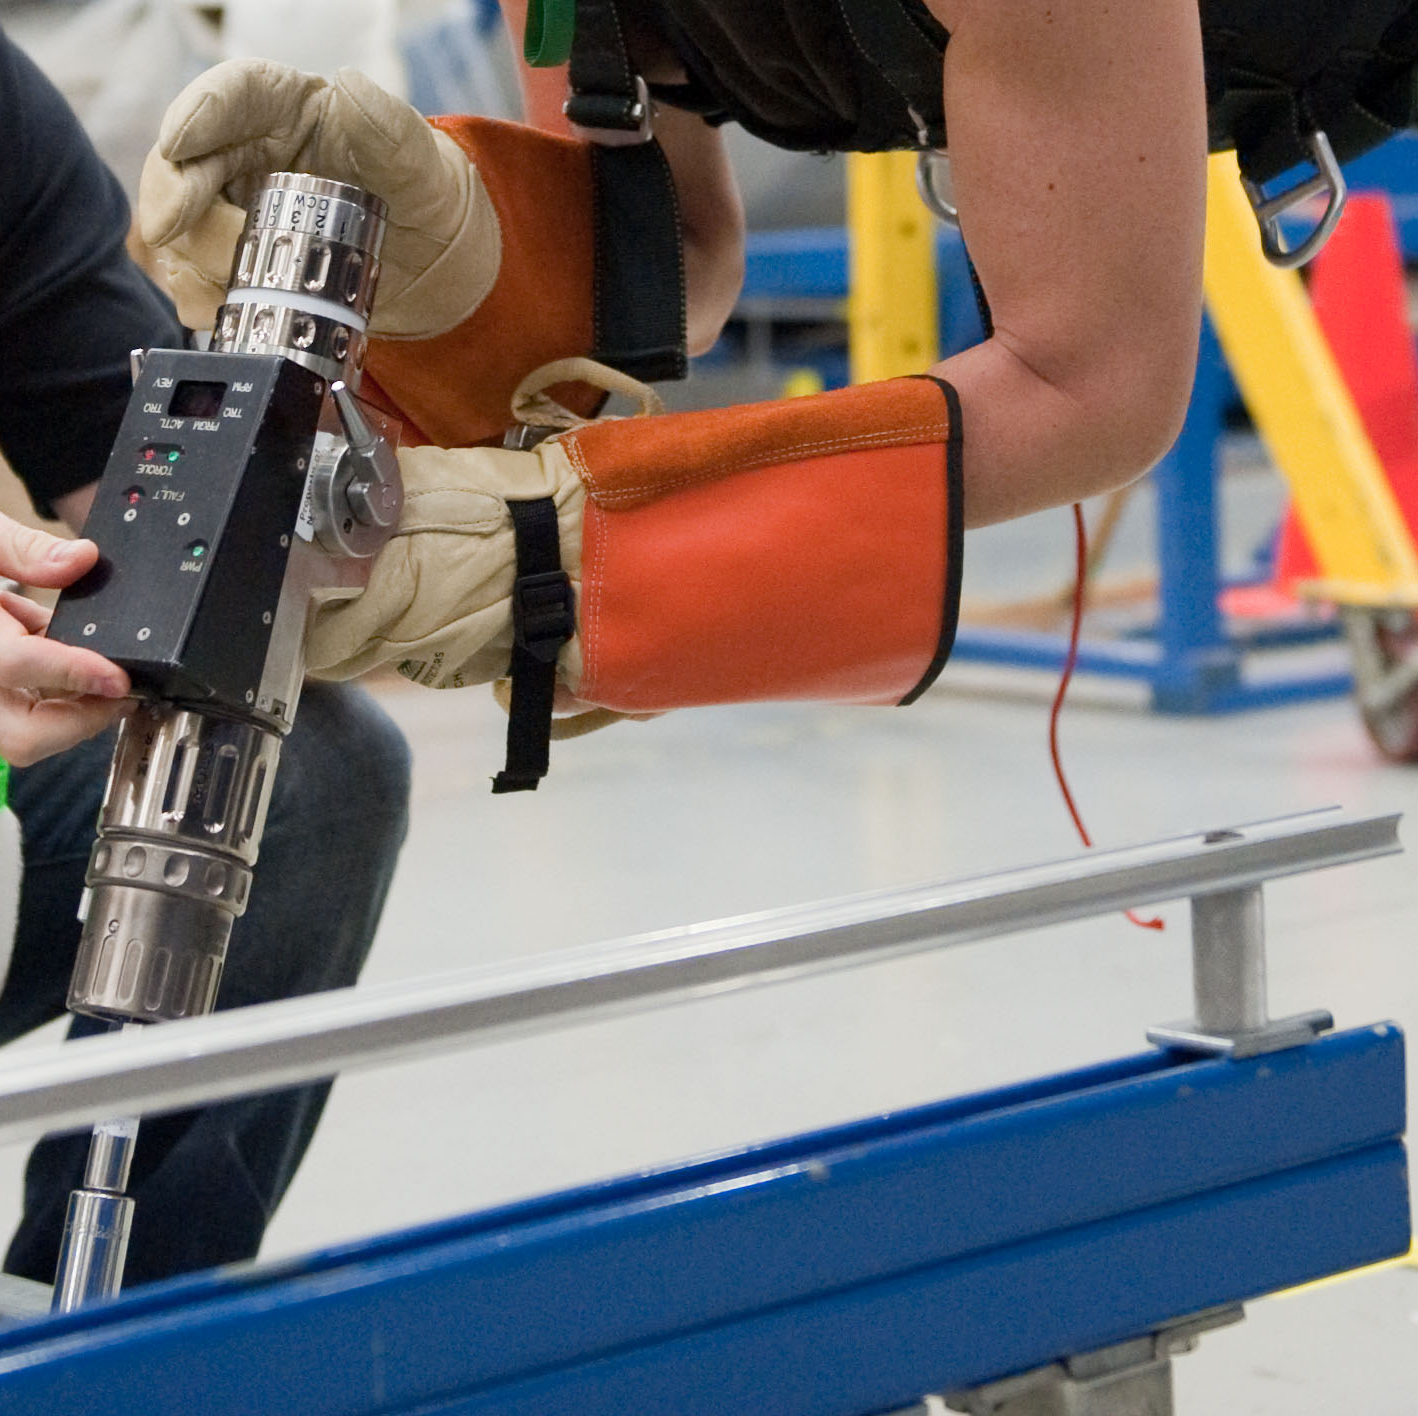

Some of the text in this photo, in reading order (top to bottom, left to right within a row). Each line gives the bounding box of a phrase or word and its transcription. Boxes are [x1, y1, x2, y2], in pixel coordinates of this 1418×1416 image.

[294, 194, 329, 211] CCW
[291, 210, 301, 224] 3
[315, 214, 326, 229] 2
[152, 377, 173, 388] REV
[231, 381, 253, 392] RPM
[160, 417, 220, 431] PRGM ACTL
[136, 464, 173, 476] TORQUE
[152, 489, 185, 501] FAULT
[180, 560, 203, 572] PWR
